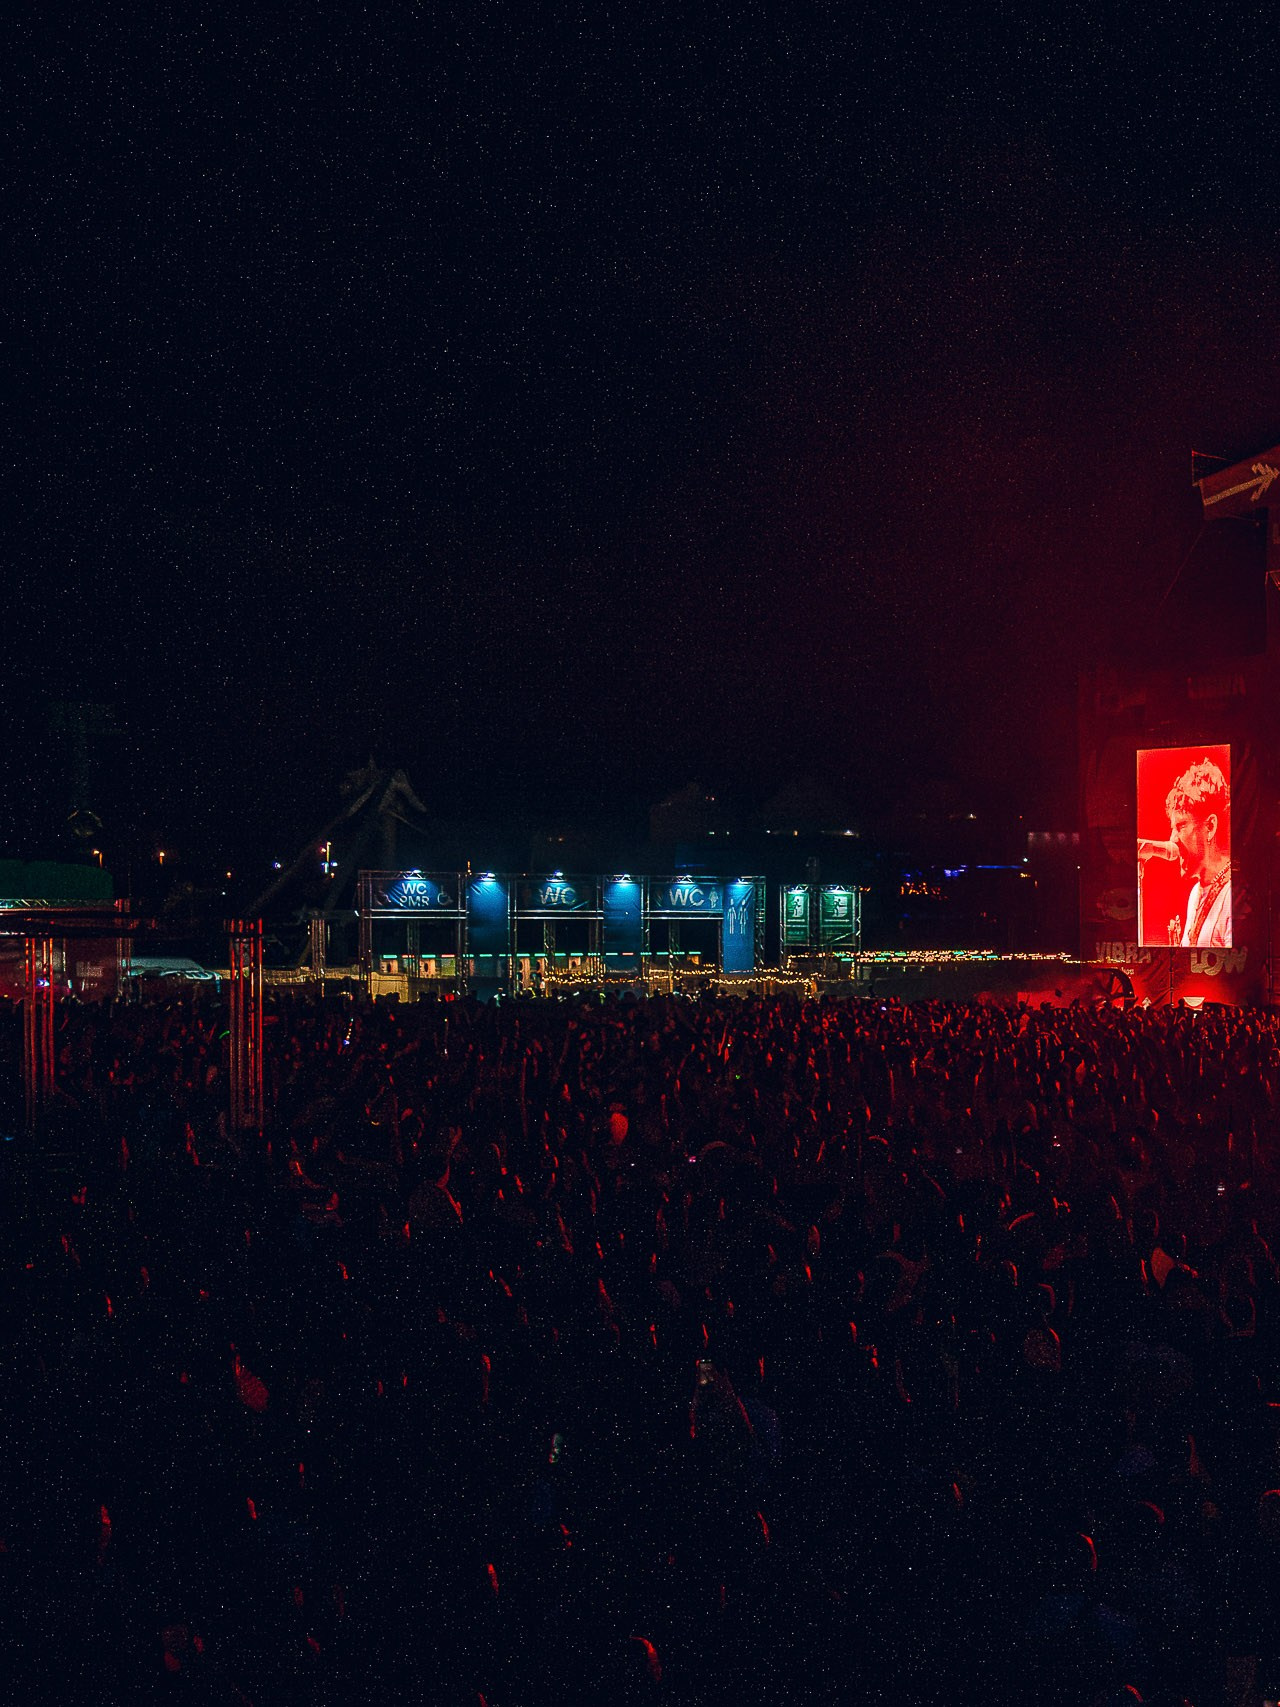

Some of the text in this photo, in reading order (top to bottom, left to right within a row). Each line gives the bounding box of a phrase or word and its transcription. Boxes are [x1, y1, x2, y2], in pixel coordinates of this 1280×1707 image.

[401, 882, 427, 895] WC
[539, 887, 576, 905] WC
[669, 887, 705, 907] WC
[1095, 942, 1151, 963] VIBRA
[1190, 946, 1248, 976] LOW
